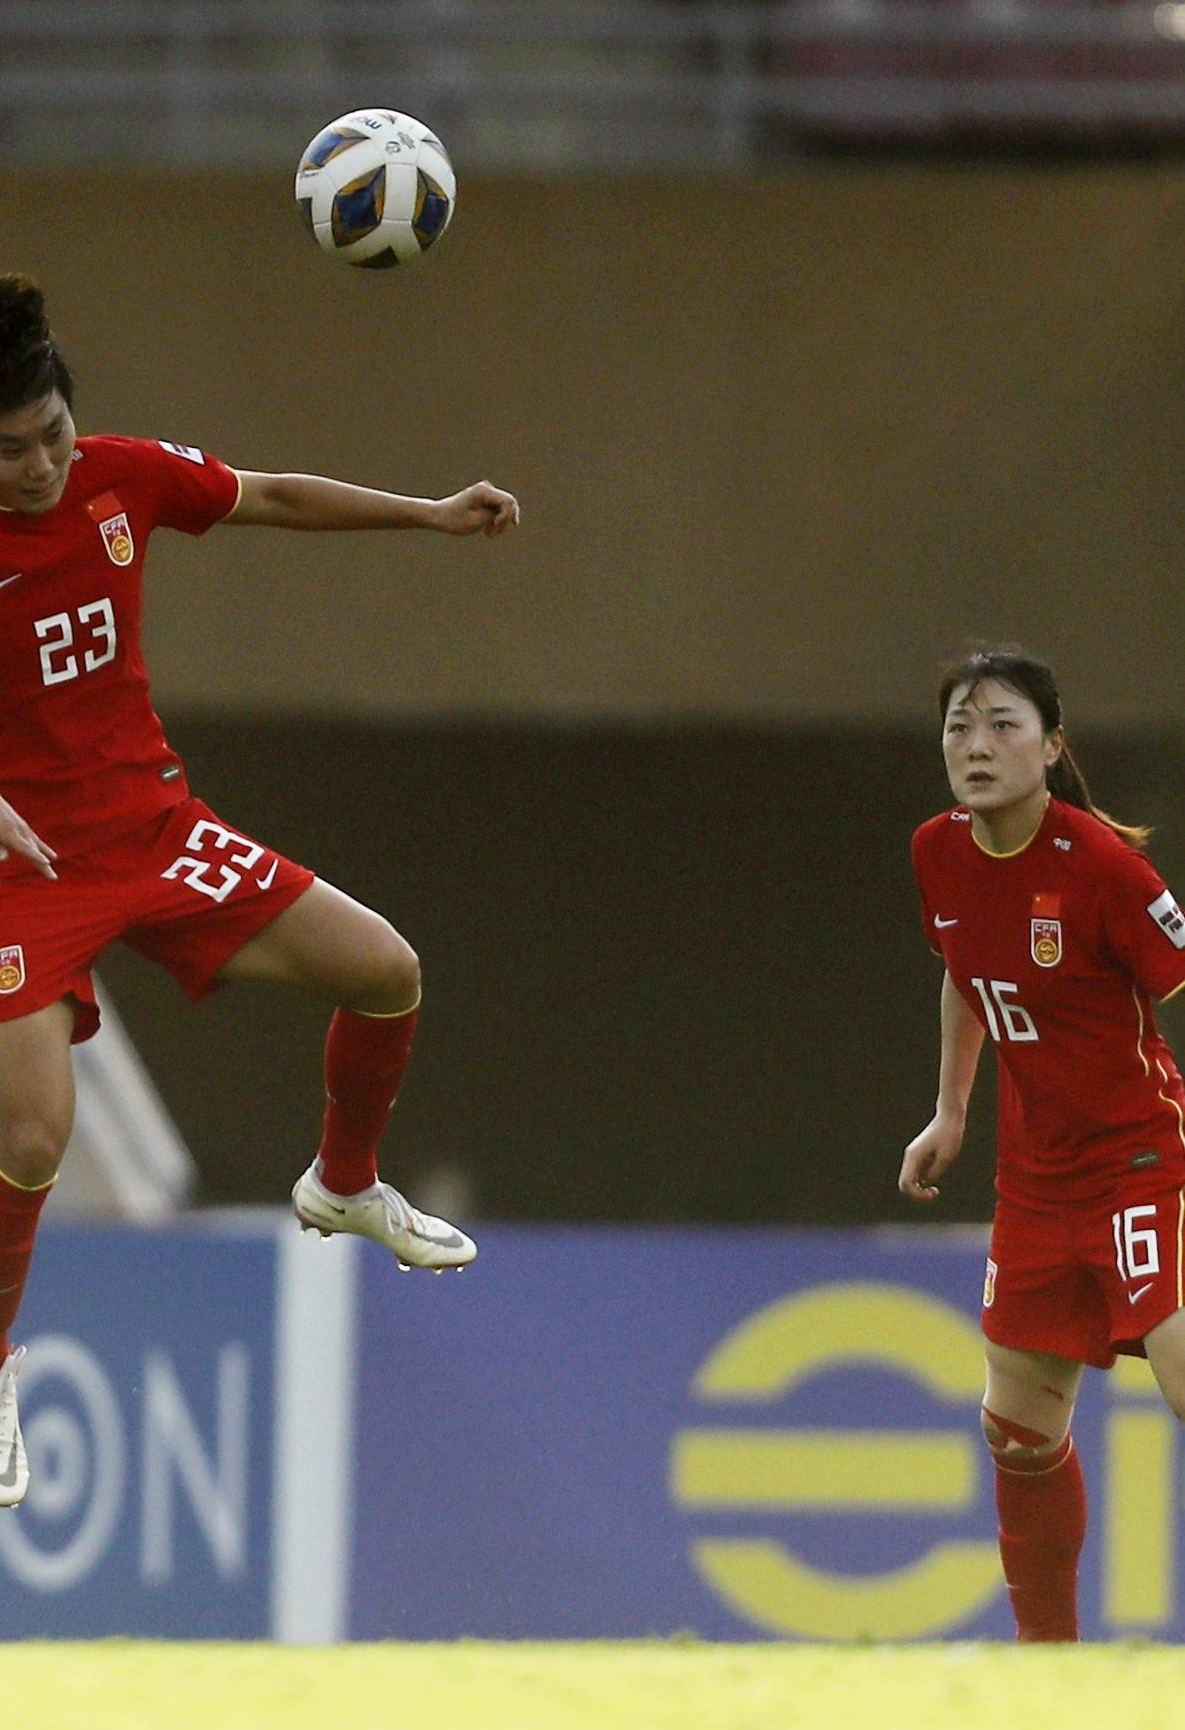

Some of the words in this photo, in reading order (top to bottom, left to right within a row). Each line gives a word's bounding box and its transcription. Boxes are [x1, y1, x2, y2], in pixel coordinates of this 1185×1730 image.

[34, 597, 117, 686] 23
[161, 819, 265, 902] 23
[971, 977, 1039, 1041] 16
[1112, 1204, 1160, 1282] 16
